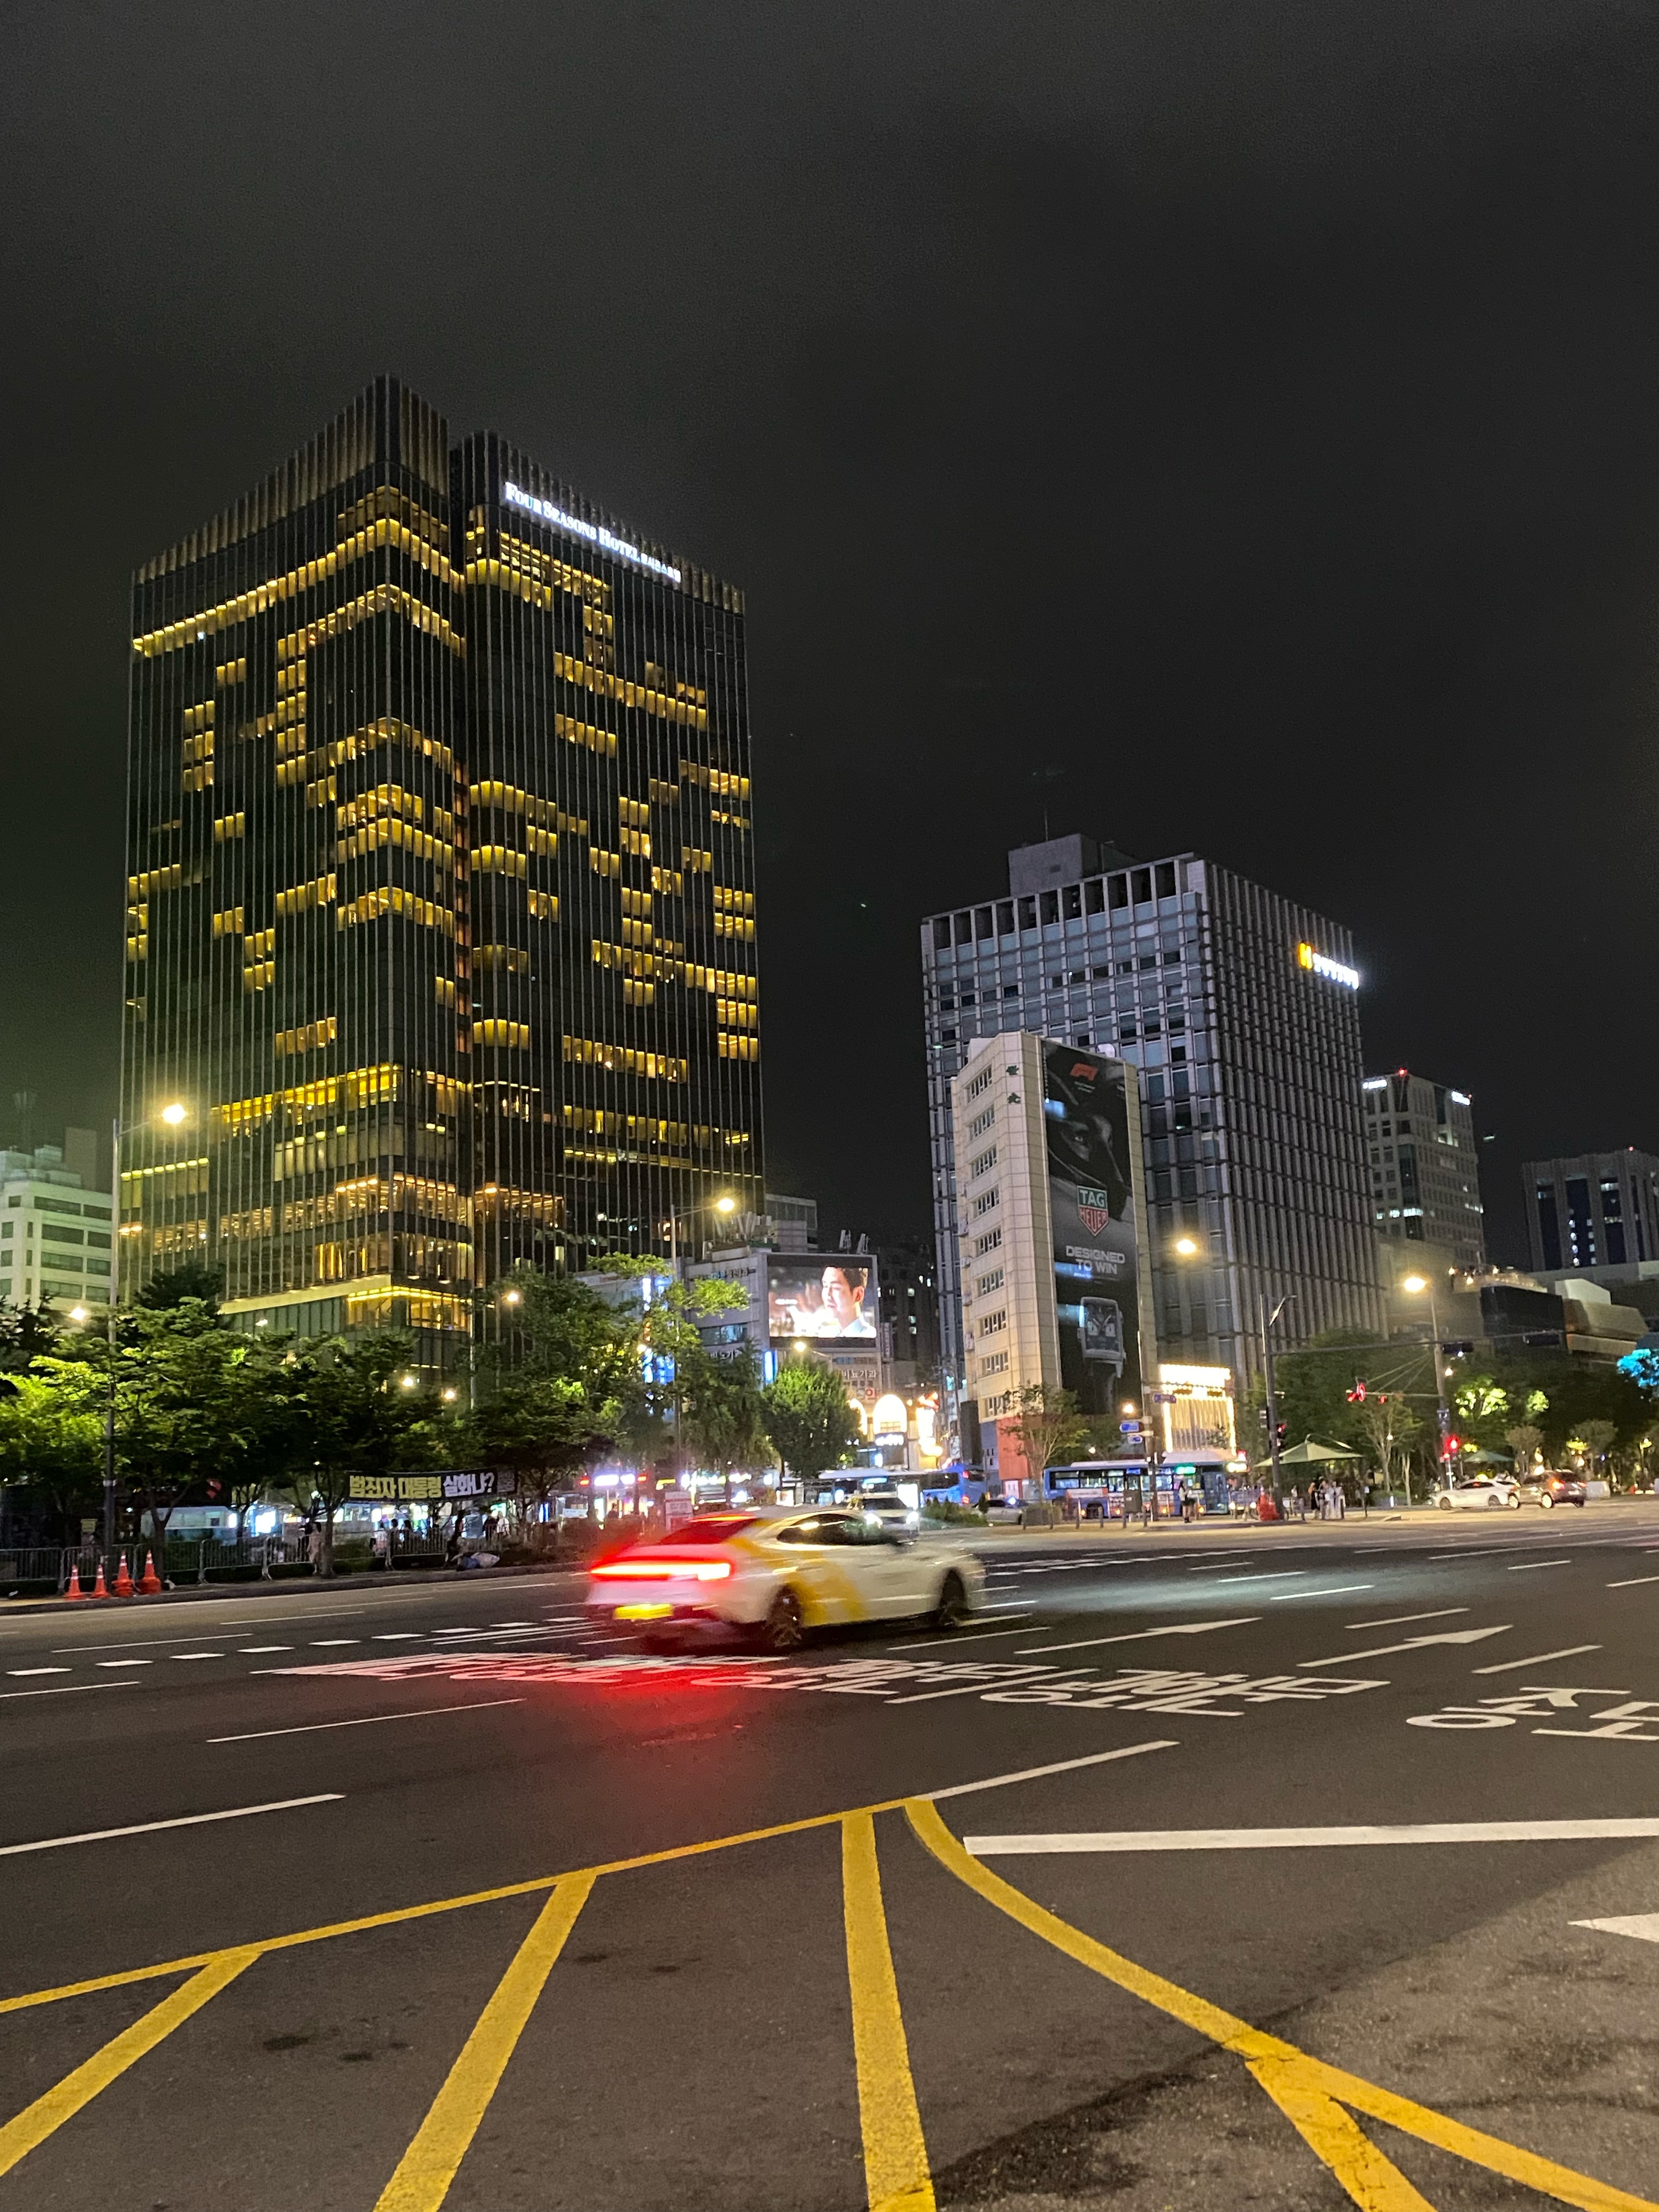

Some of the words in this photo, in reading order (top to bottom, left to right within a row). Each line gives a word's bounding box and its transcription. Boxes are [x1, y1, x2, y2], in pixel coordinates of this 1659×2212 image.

[1079, 1190, 1105, 1208] TAG
[1079, 1208, 1107, 1233] HEUER
[1066, 1245, 1125, 1264] DESIGNED
[1076, 1259, 1092, 1271] TO
[1095, 1261, 1117, 1274] WIN
[841, 1369, 877, 1380] 비뇨기과
[398, 1476, 442, 1499] 대통령
[443, 1473, 494, 1498] 실화냐?
[690, 1658, 1059, 1694] 광화문
[980, 1669, 1390, 1717] 광화문
